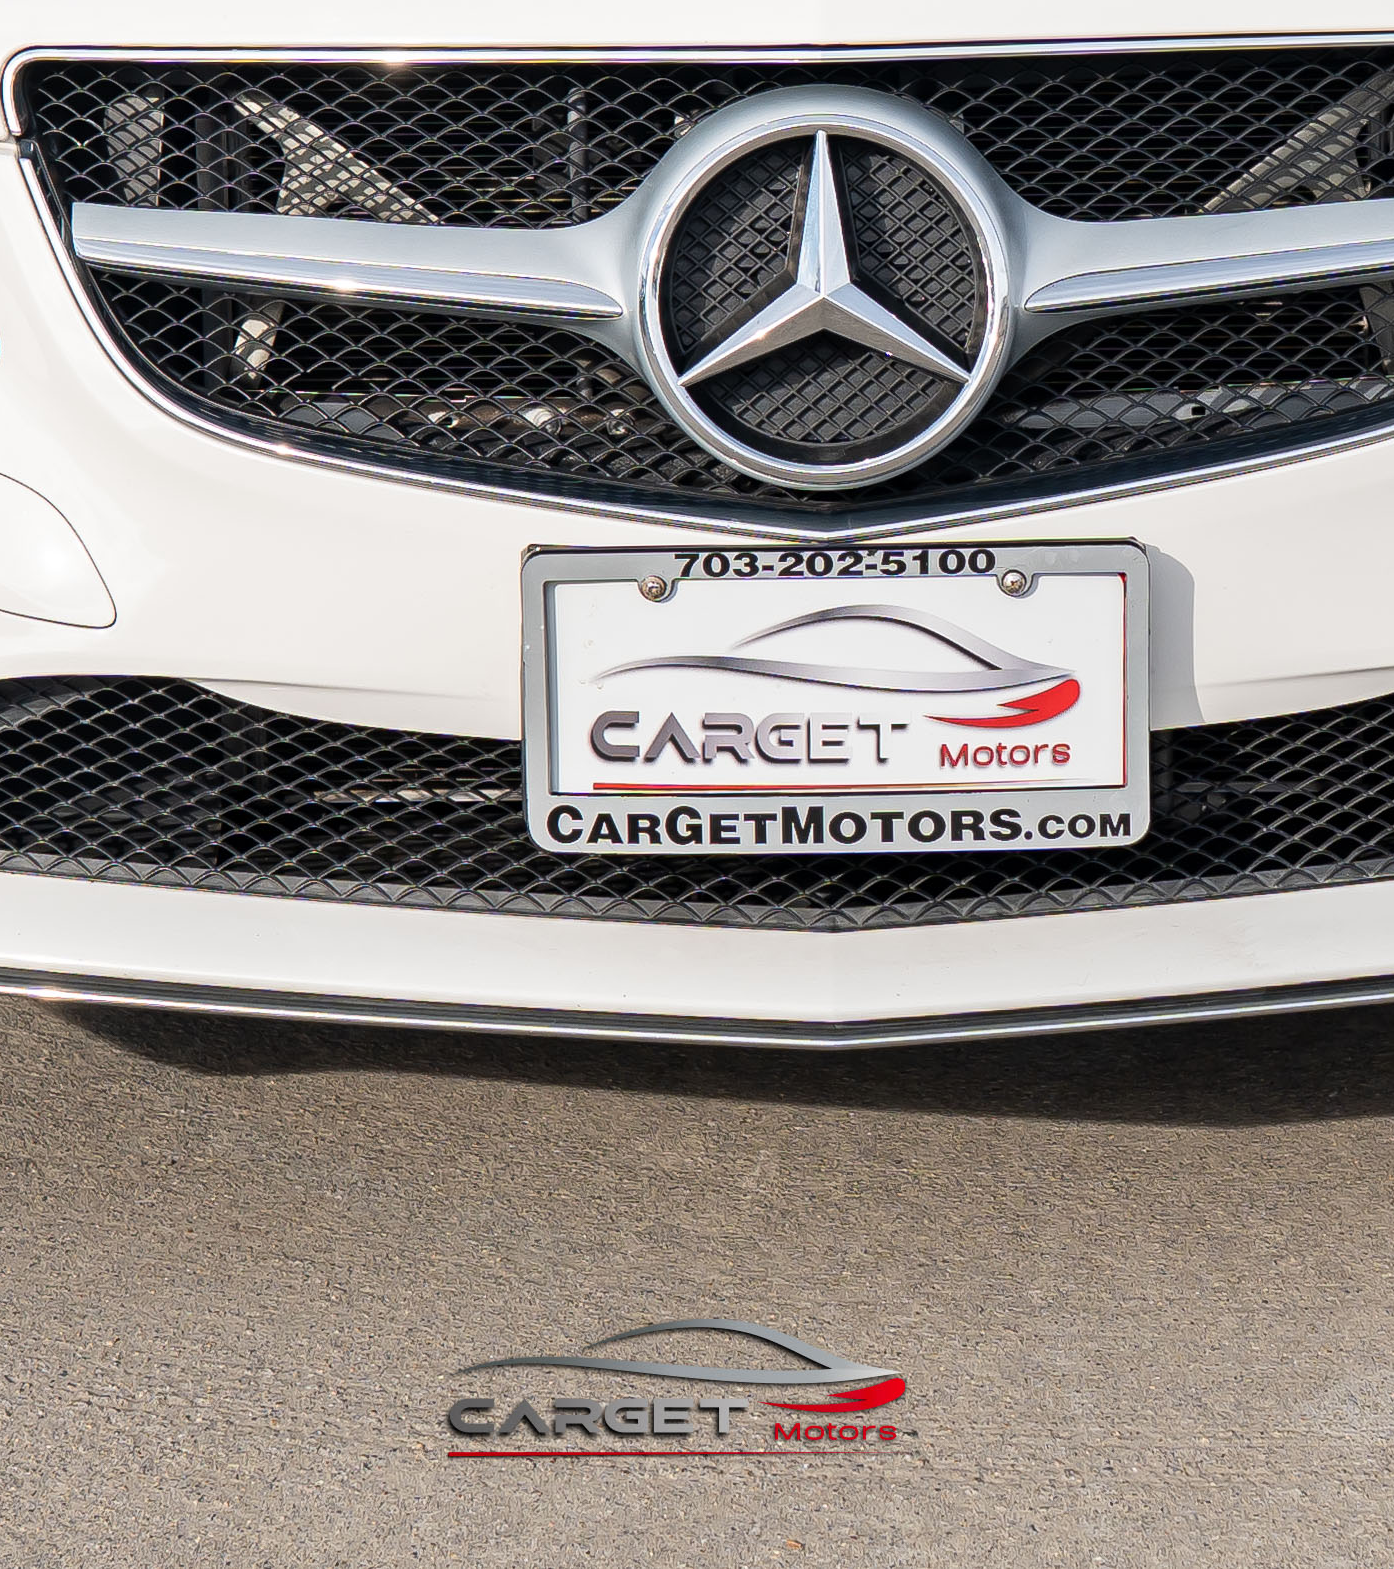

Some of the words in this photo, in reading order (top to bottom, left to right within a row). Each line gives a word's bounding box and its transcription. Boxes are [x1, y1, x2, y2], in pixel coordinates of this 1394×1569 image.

[673, 549, 996, 579] 703-202-5100
[590, 711, 908, 764] CARGET
[939, 741, 1072, 769] Motors
